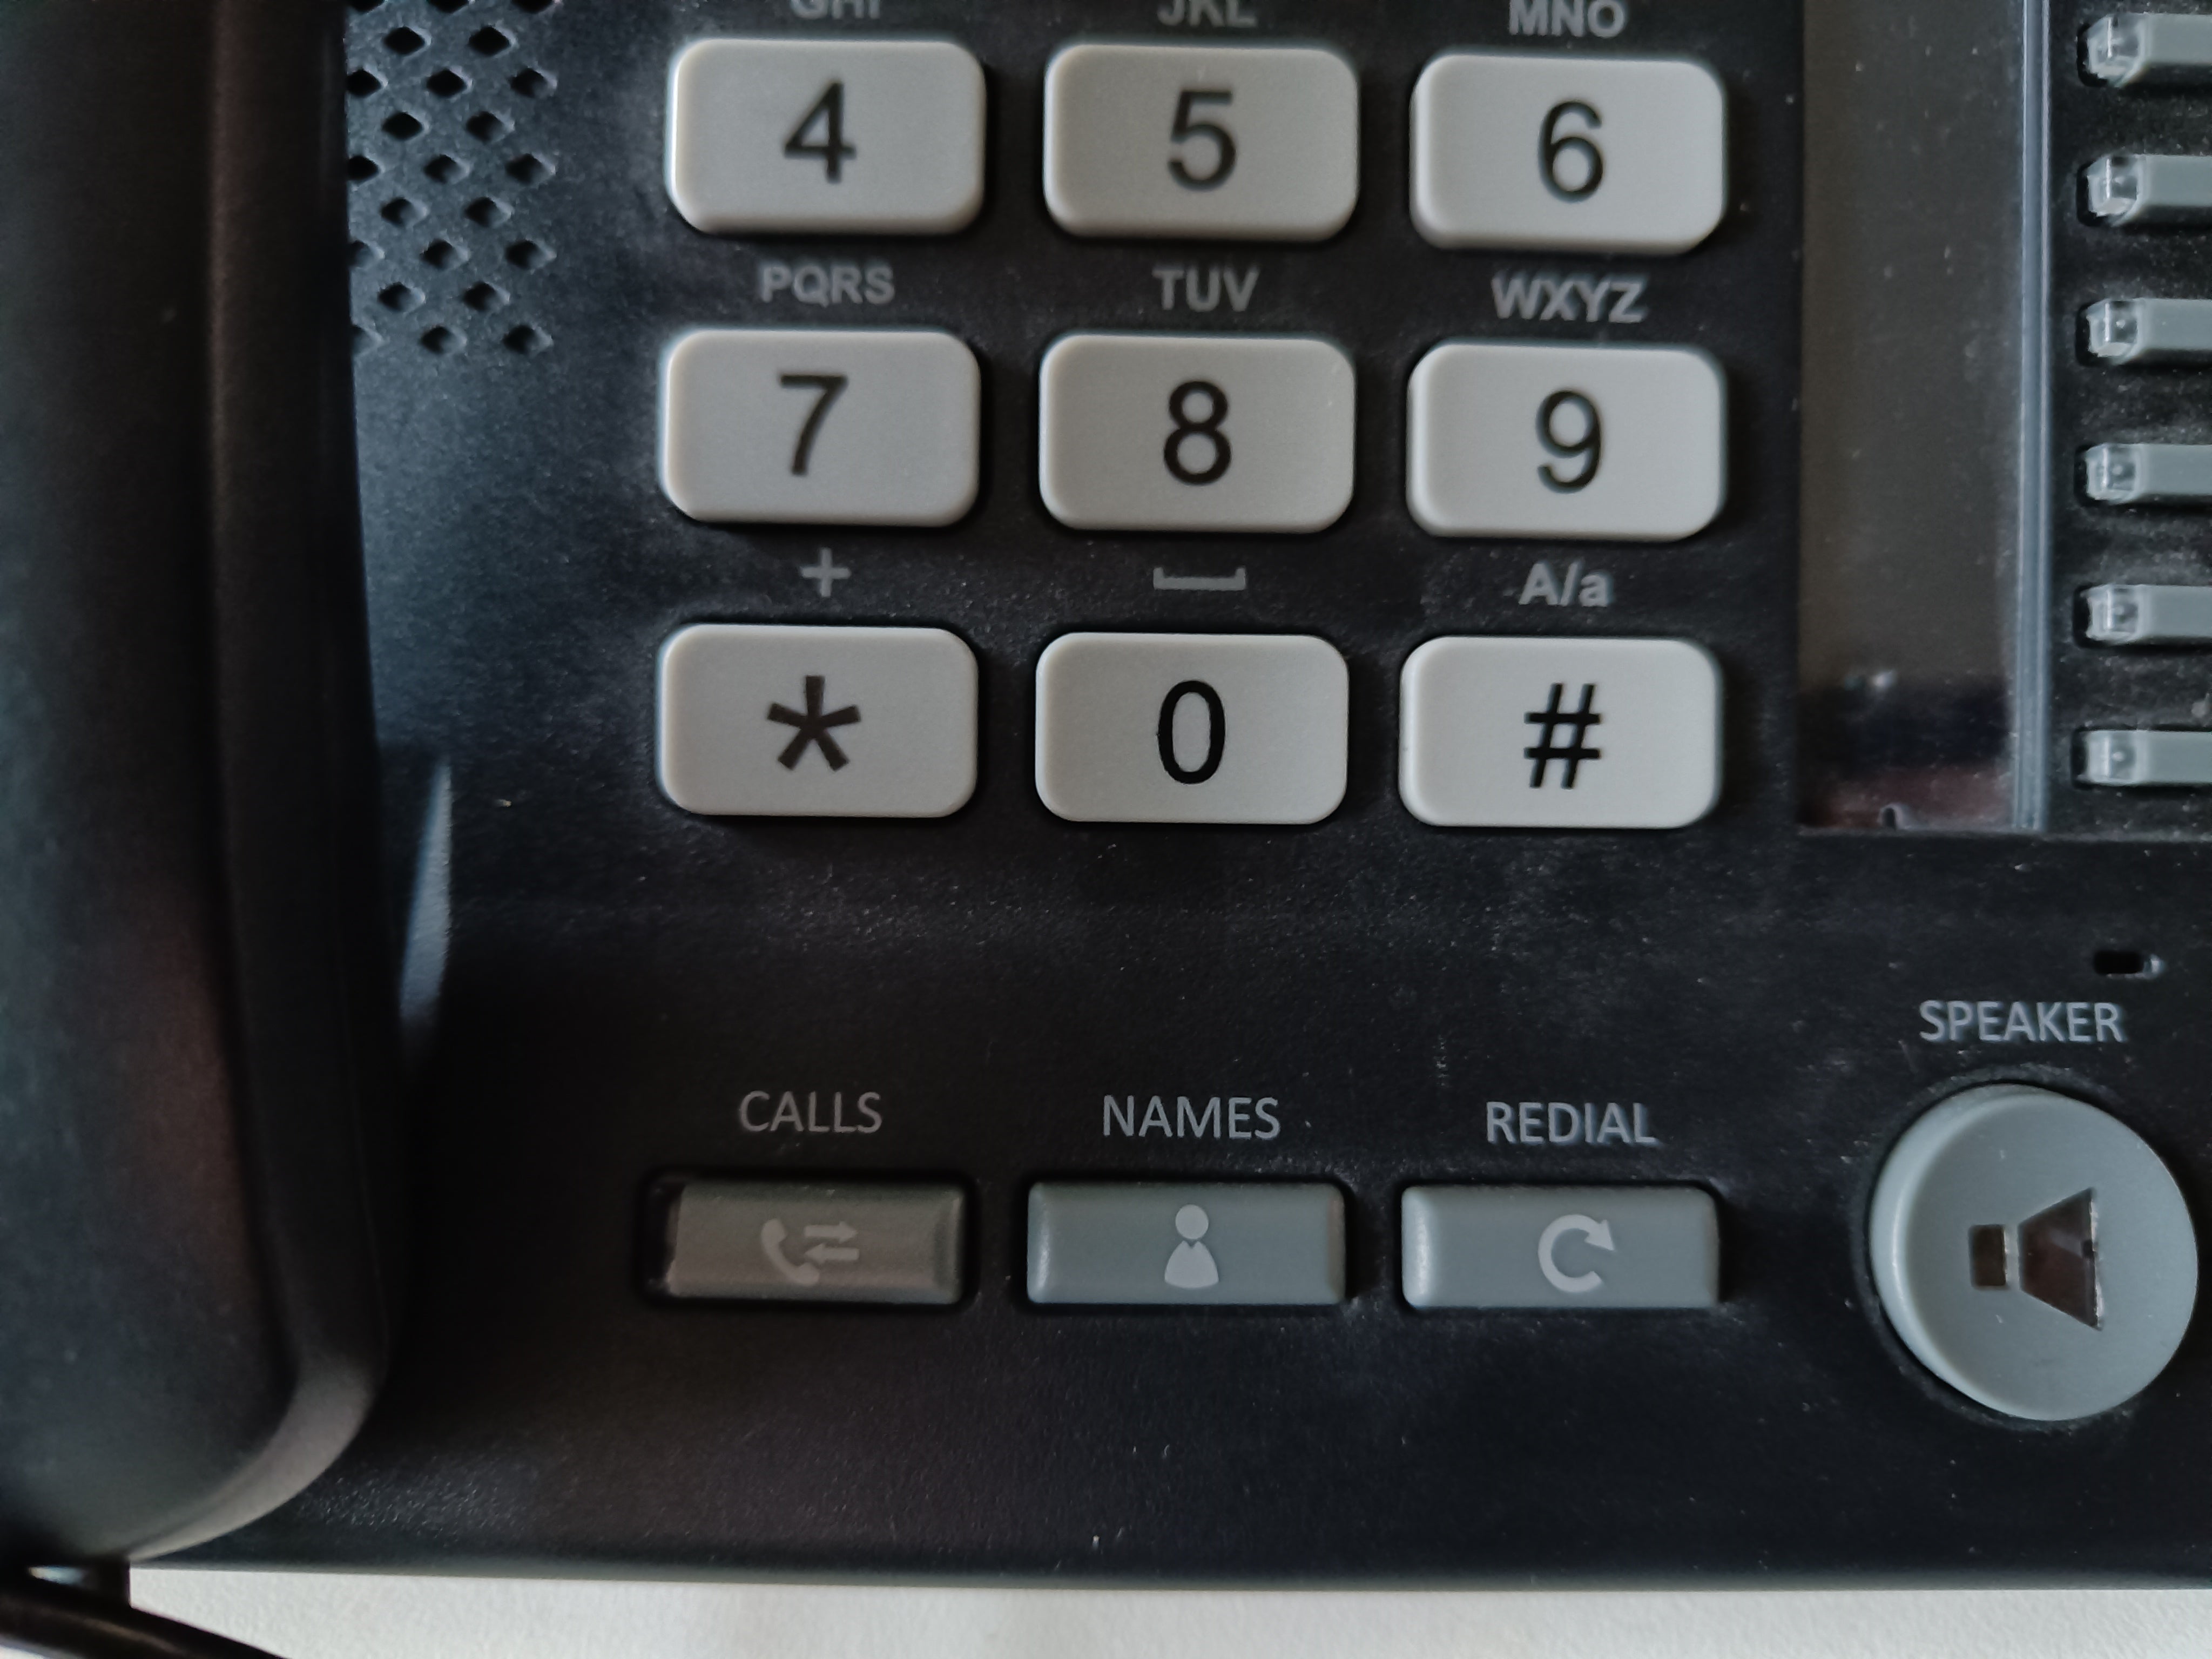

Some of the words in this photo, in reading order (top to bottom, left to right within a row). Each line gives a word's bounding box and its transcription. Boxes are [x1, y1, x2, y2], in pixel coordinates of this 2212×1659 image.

[1508, 0, 1627, 39] MNO
[783, 80, 857, 184] 4
[1166, 87, 1237, 192] 5
[1537, 98, 1605, 203] 6
[757, 264, 895, 308] PQRS
[1152, 267, 1259, 312] TUV
[1491, 274, 1645, 324] WXYZ
[779, 373, 848, 477] 7
[1162, 379, 1232, 487] 8
[1535, 388, 1603, 494] 9
[1520, 564, 1611, 608] A/a
[1523, 683, 1602, 790] #
[1919, 999, 2124, 1043] SPEAKER
[738, 1090, 883, 1134] CALLS
[1103, 1094, 1281, 1141] NAMES
[1486, 1101, 1660, 1147] REDIAL
